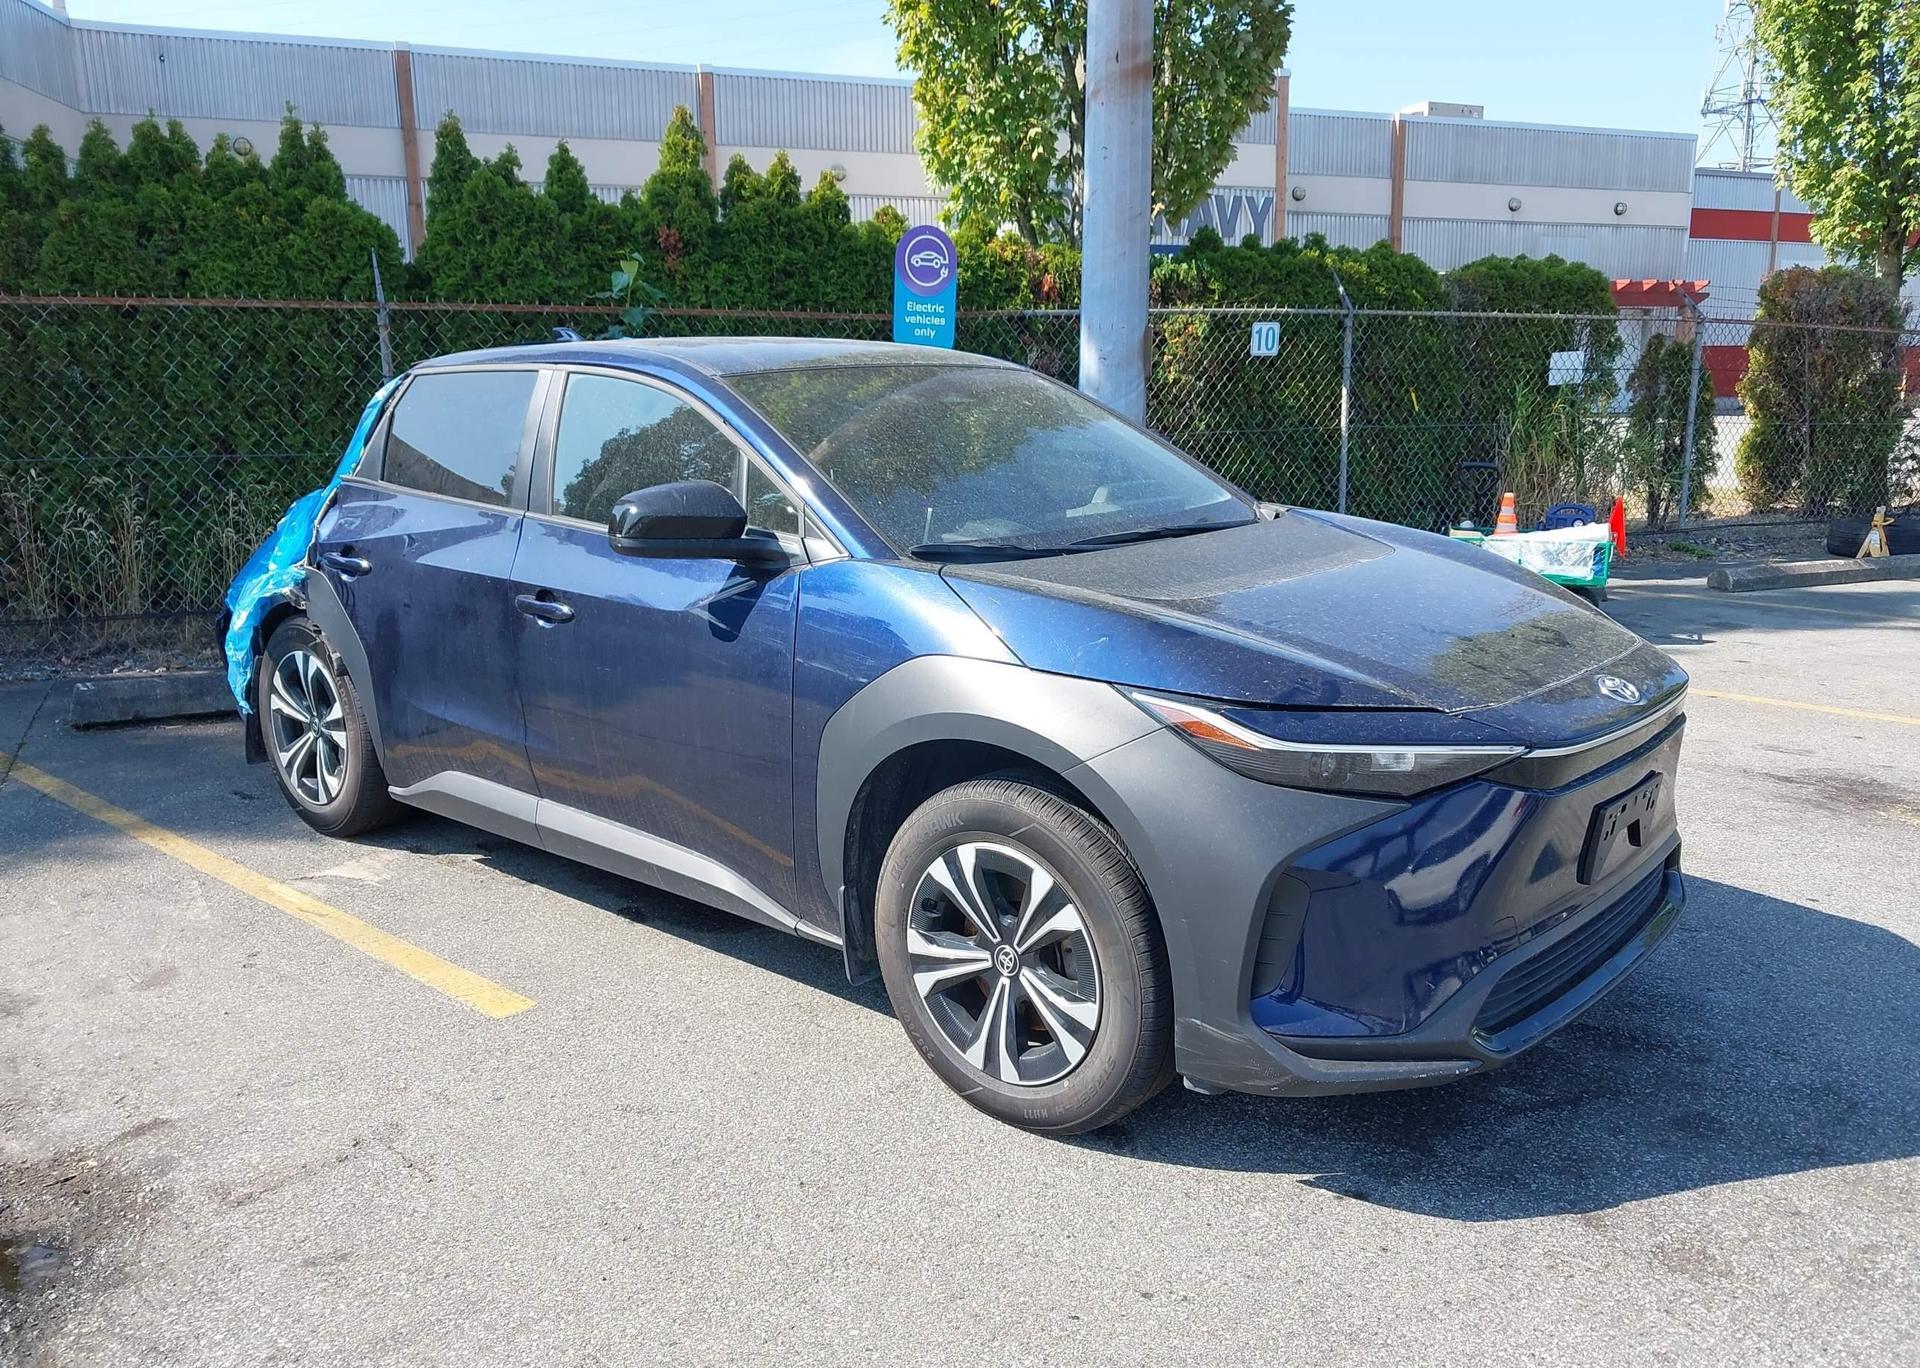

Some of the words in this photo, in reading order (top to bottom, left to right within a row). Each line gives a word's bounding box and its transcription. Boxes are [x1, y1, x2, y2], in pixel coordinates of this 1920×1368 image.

[906, 301, 945, 313] Electric
[904, 314, 946, 325] vehicles
[914, 327, 936, 339] only
[1255, 326, 1276, 351] 10
